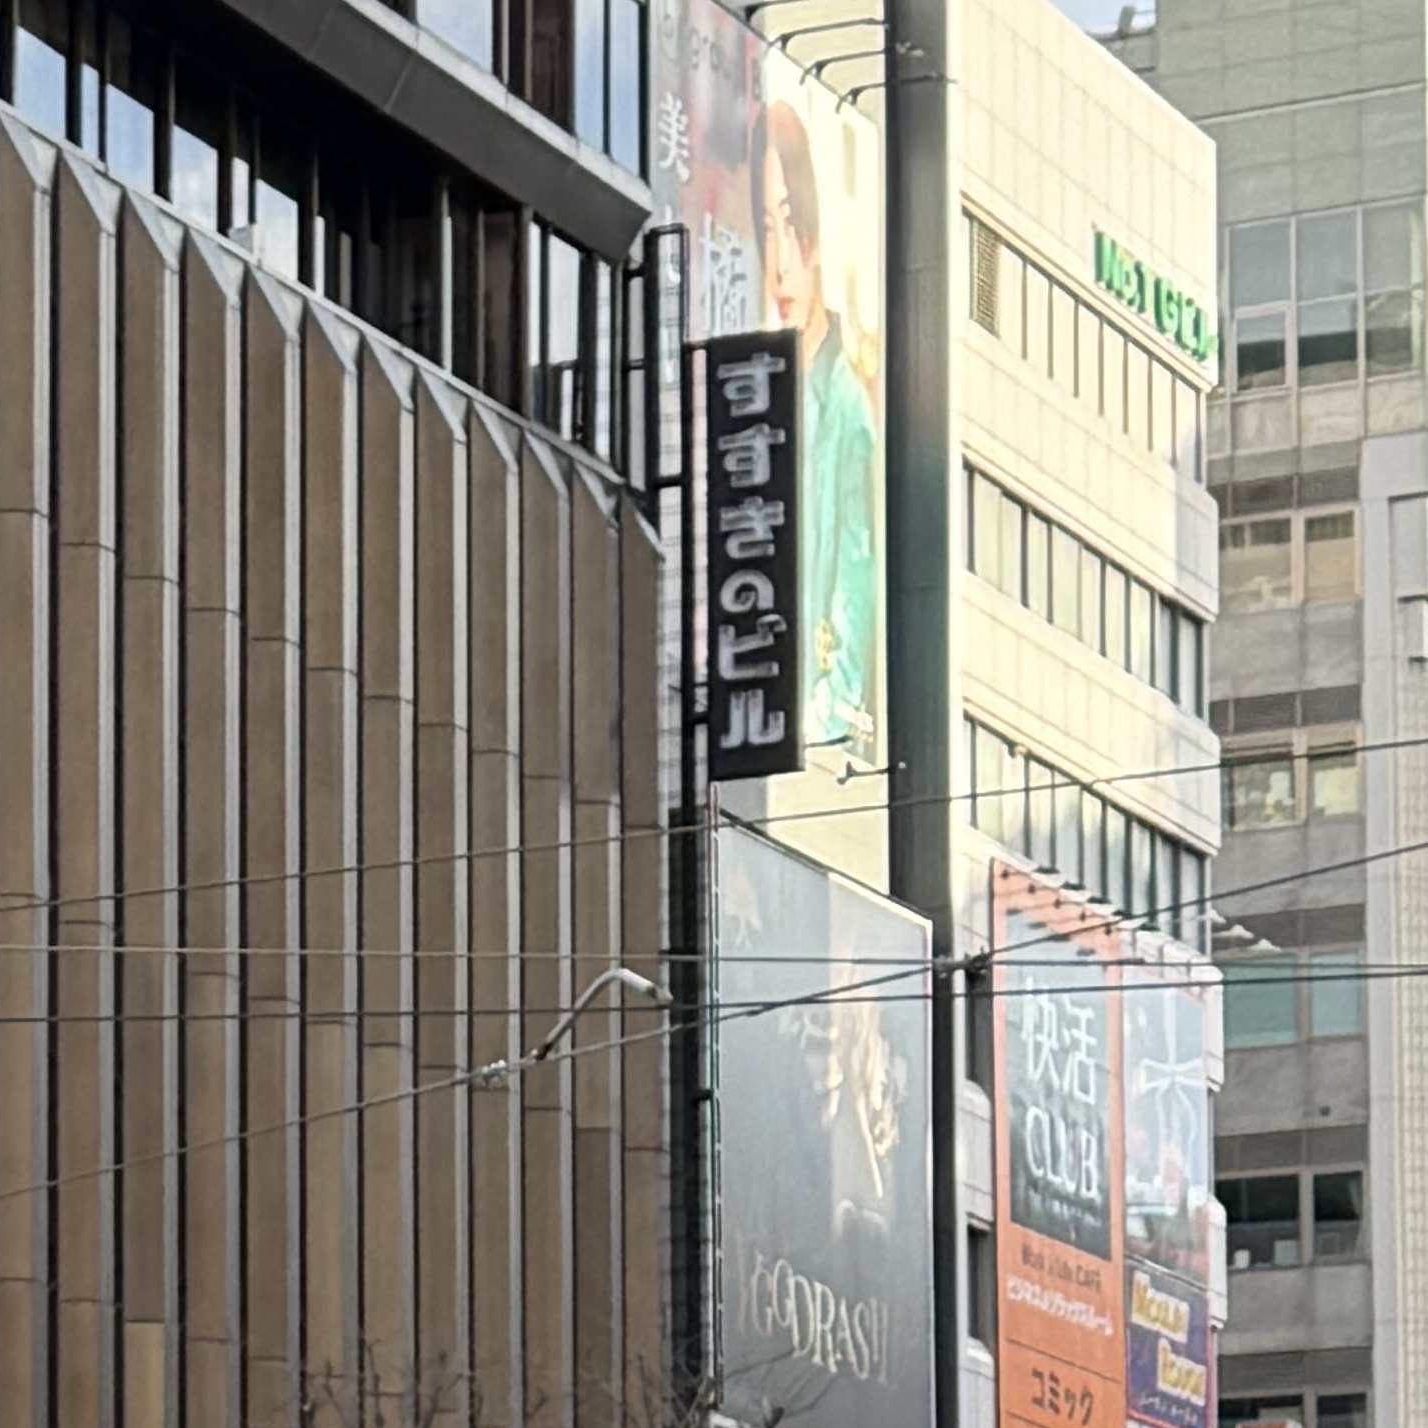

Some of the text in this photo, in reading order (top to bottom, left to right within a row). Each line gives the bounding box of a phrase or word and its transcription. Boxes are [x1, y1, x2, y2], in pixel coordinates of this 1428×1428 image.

[717, 351, 787, 749] すすきのビル
[1025, 1105, 1100, 1203] CLUB
[1031, 1368, 1093, 1427] コミック
